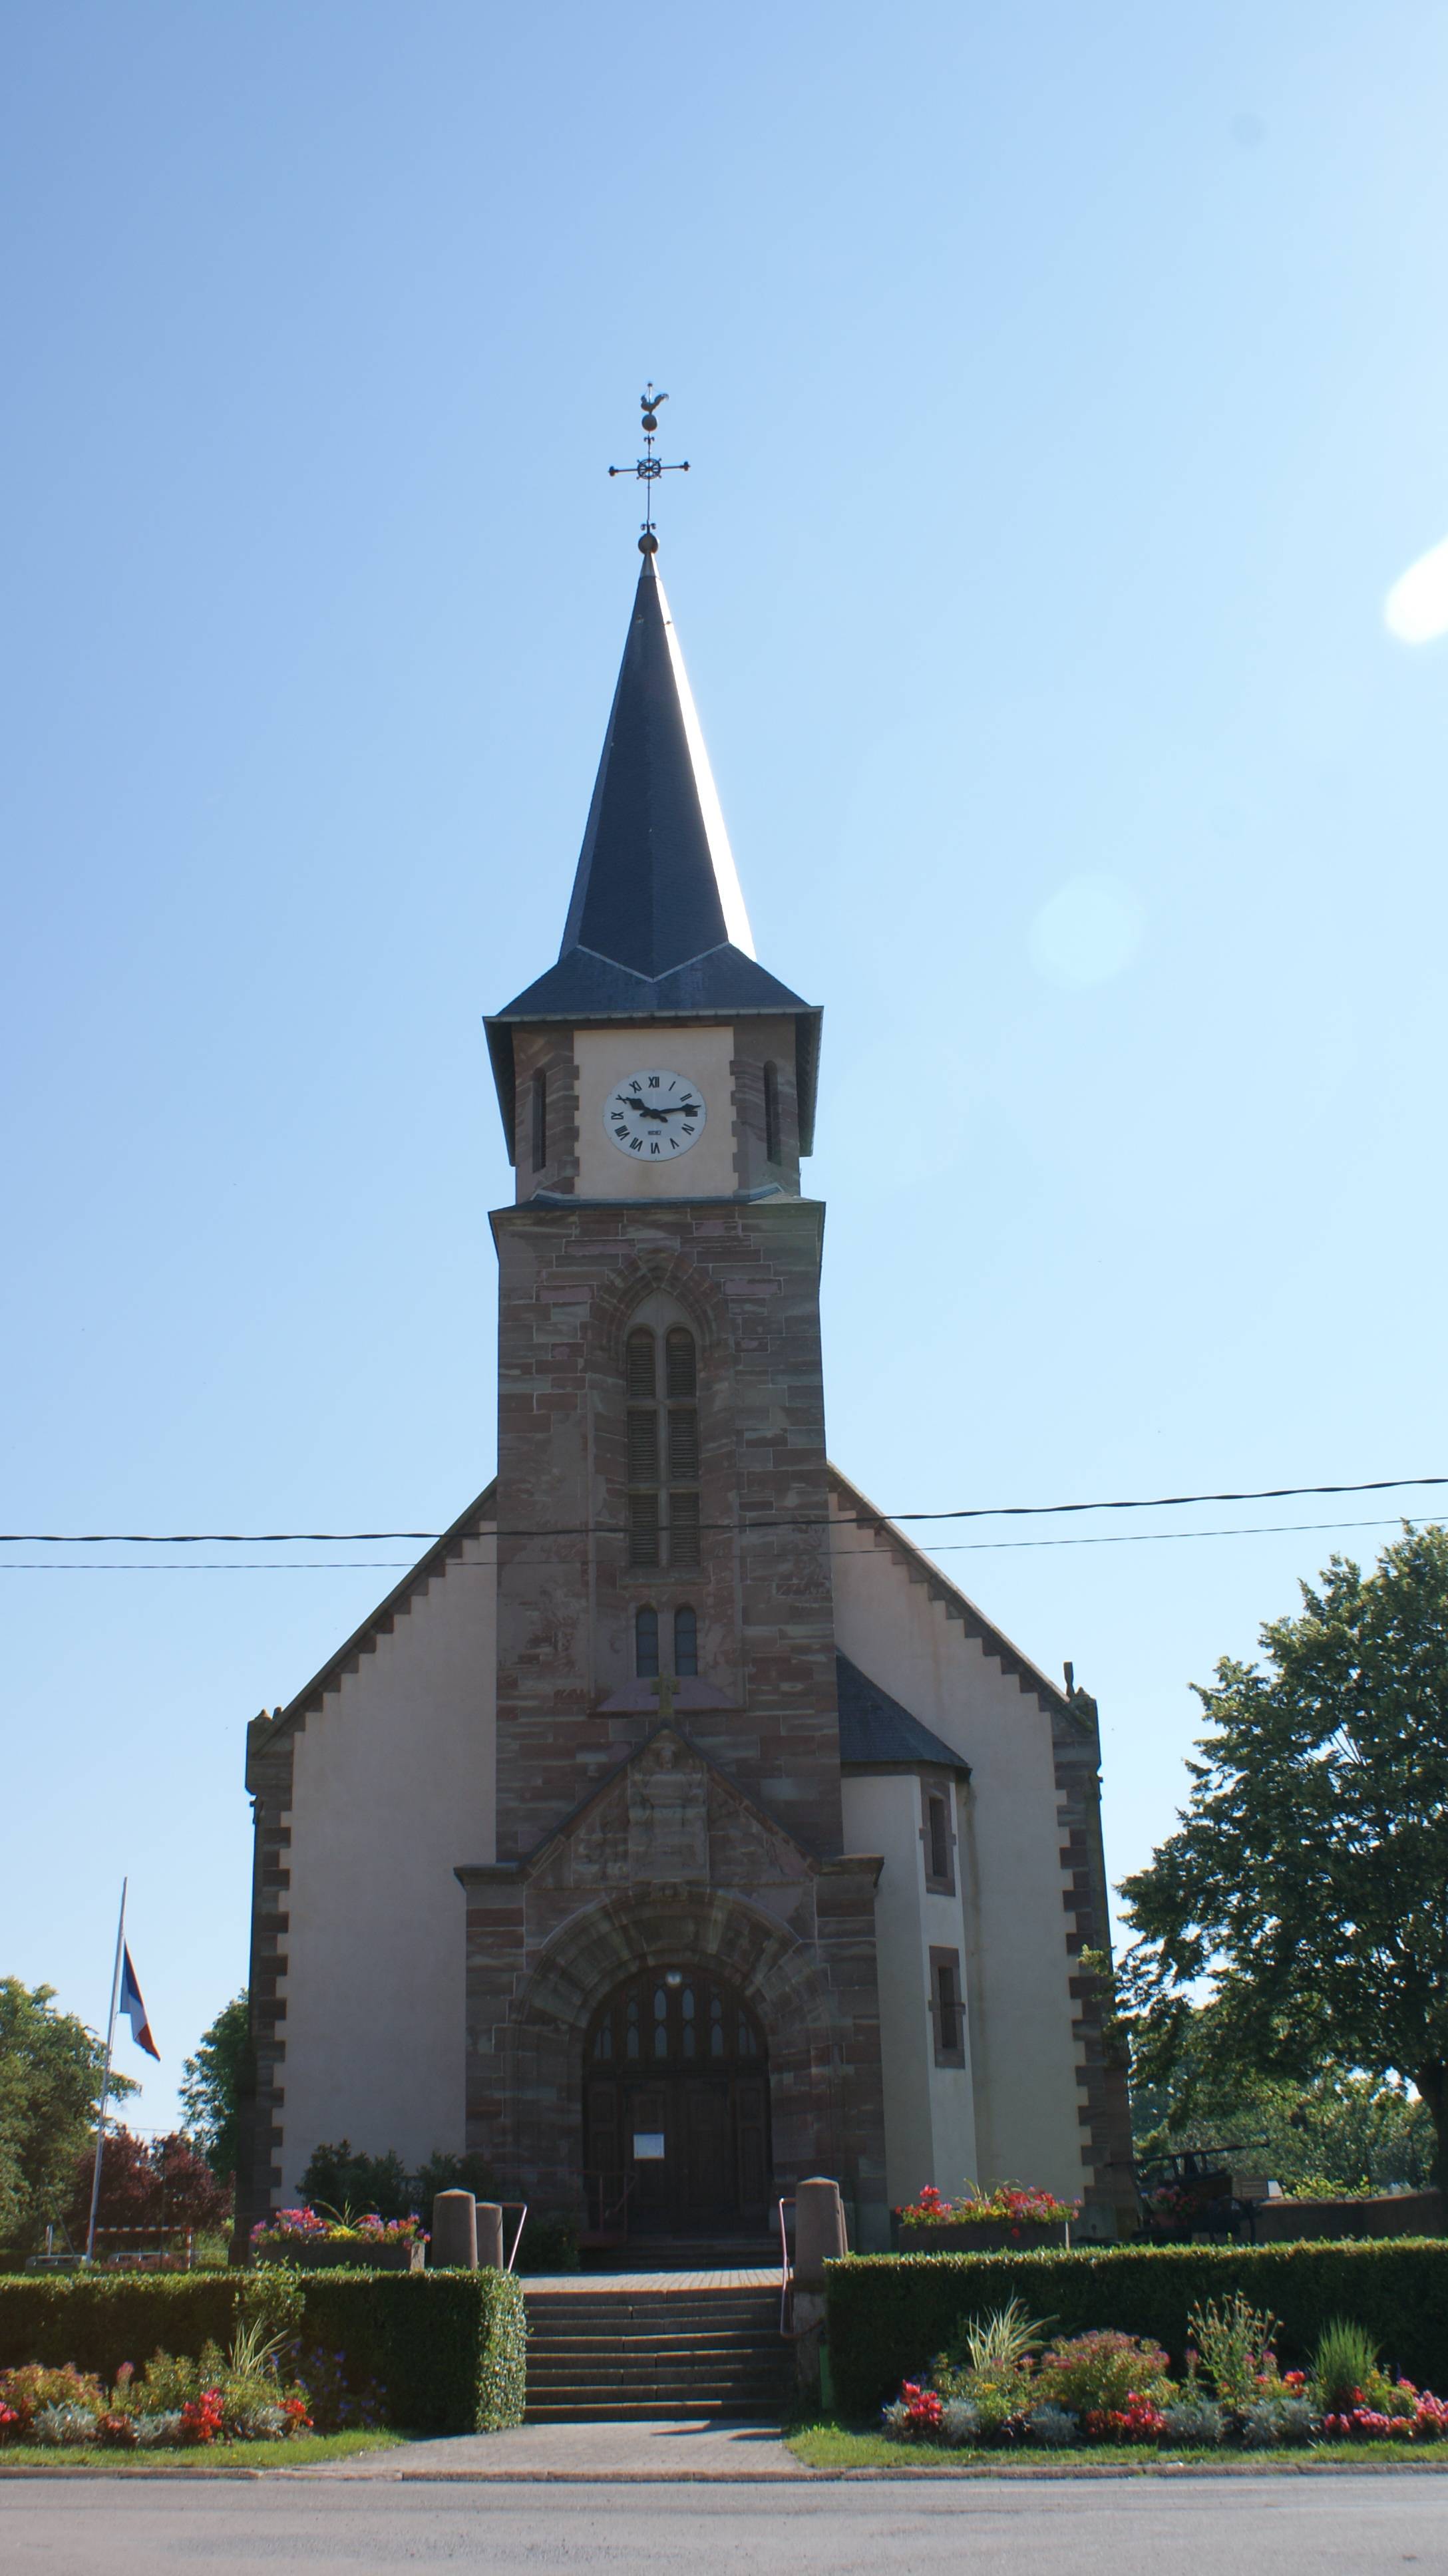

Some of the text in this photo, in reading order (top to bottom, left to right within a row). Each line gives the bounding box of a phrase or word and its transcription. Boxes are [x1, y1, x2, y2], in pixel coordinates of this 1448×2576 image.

[629, 1080, 642, 1093] XI
[648, 1076, 659, 1088] XII
[680, 1093, 692, 1102] II
[614, 1125, 630, 1141] VIII
[681, 1123, 695, 1135] IV
[630, 1137, 643, 1152] VII
[651, 1142, 660, 1154] VI
[669, 1138, 679, 1150] V
